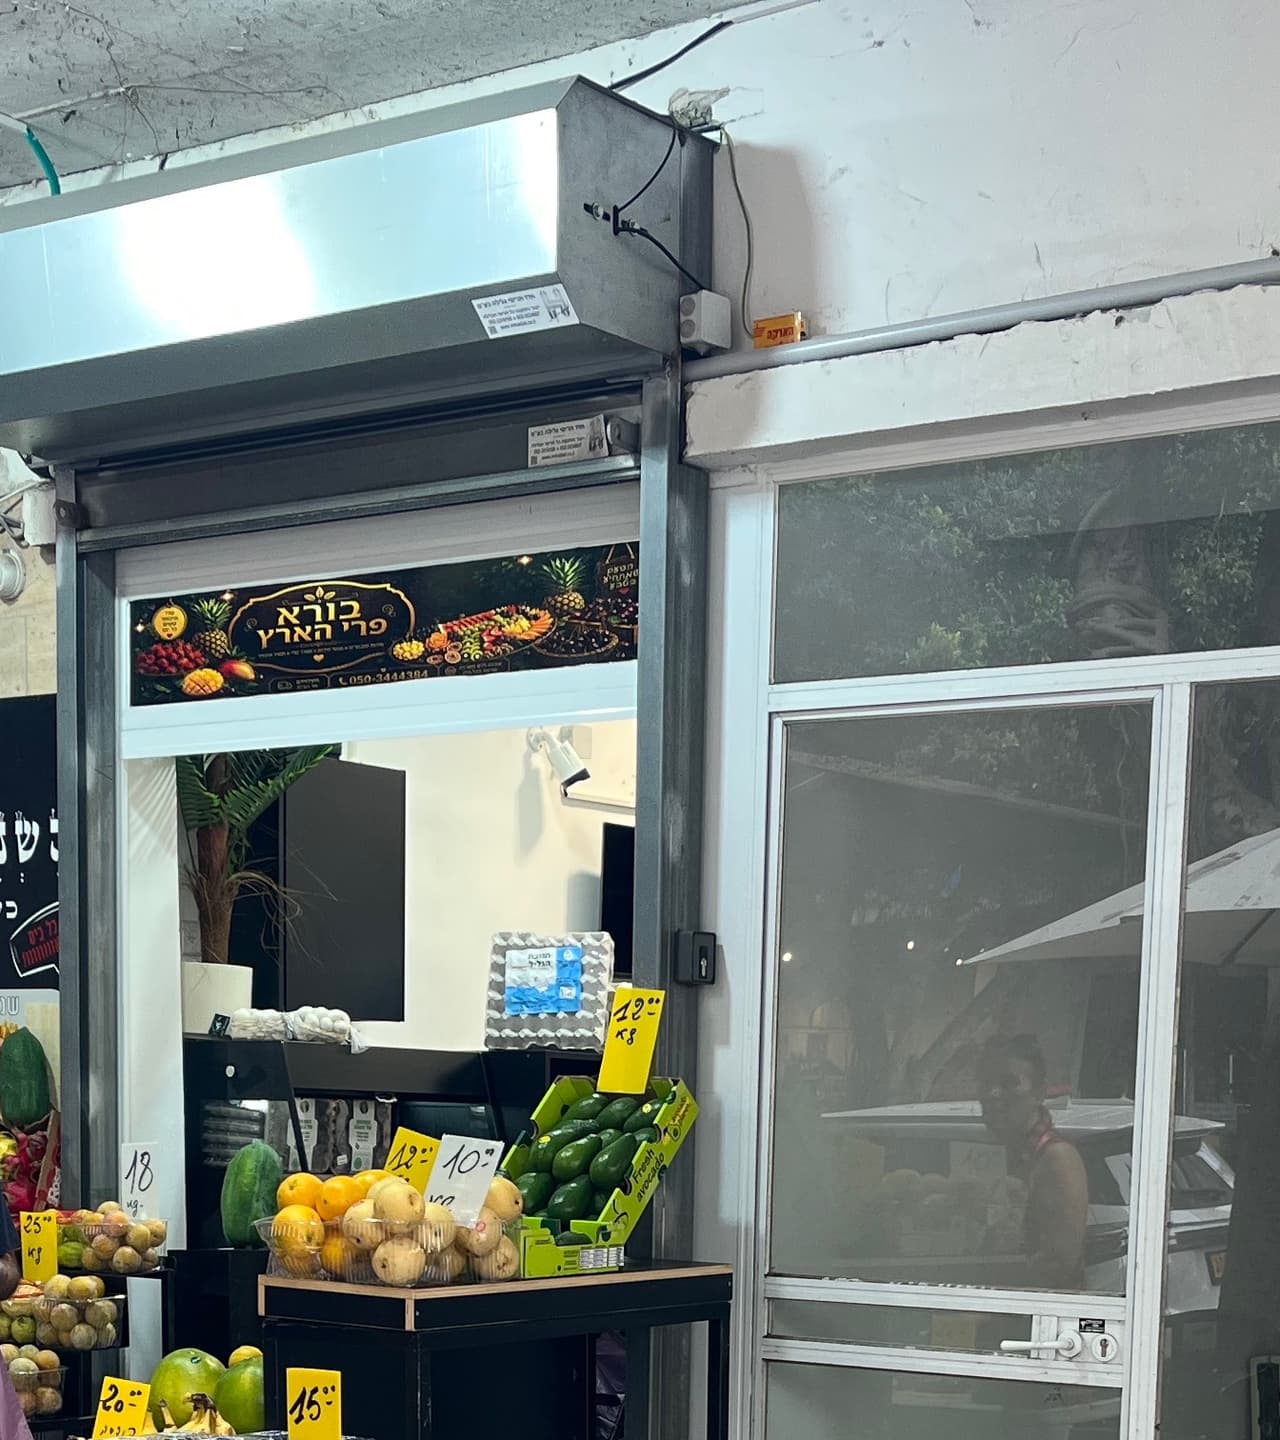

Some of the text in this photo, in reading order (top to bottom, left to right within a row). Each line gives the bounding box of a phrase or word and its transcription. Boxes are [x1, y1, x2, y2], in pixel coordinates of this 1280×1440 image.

[277, 599, 361, 626] בורא
[342, 617, 388, 637] פרי
[256, 624, 332, 650] הארץ
[124, 1149, 153, 1194] 18
[632, 1149, 655, 1184] Fresh
[637, 1152, 665, 1203] avocado
